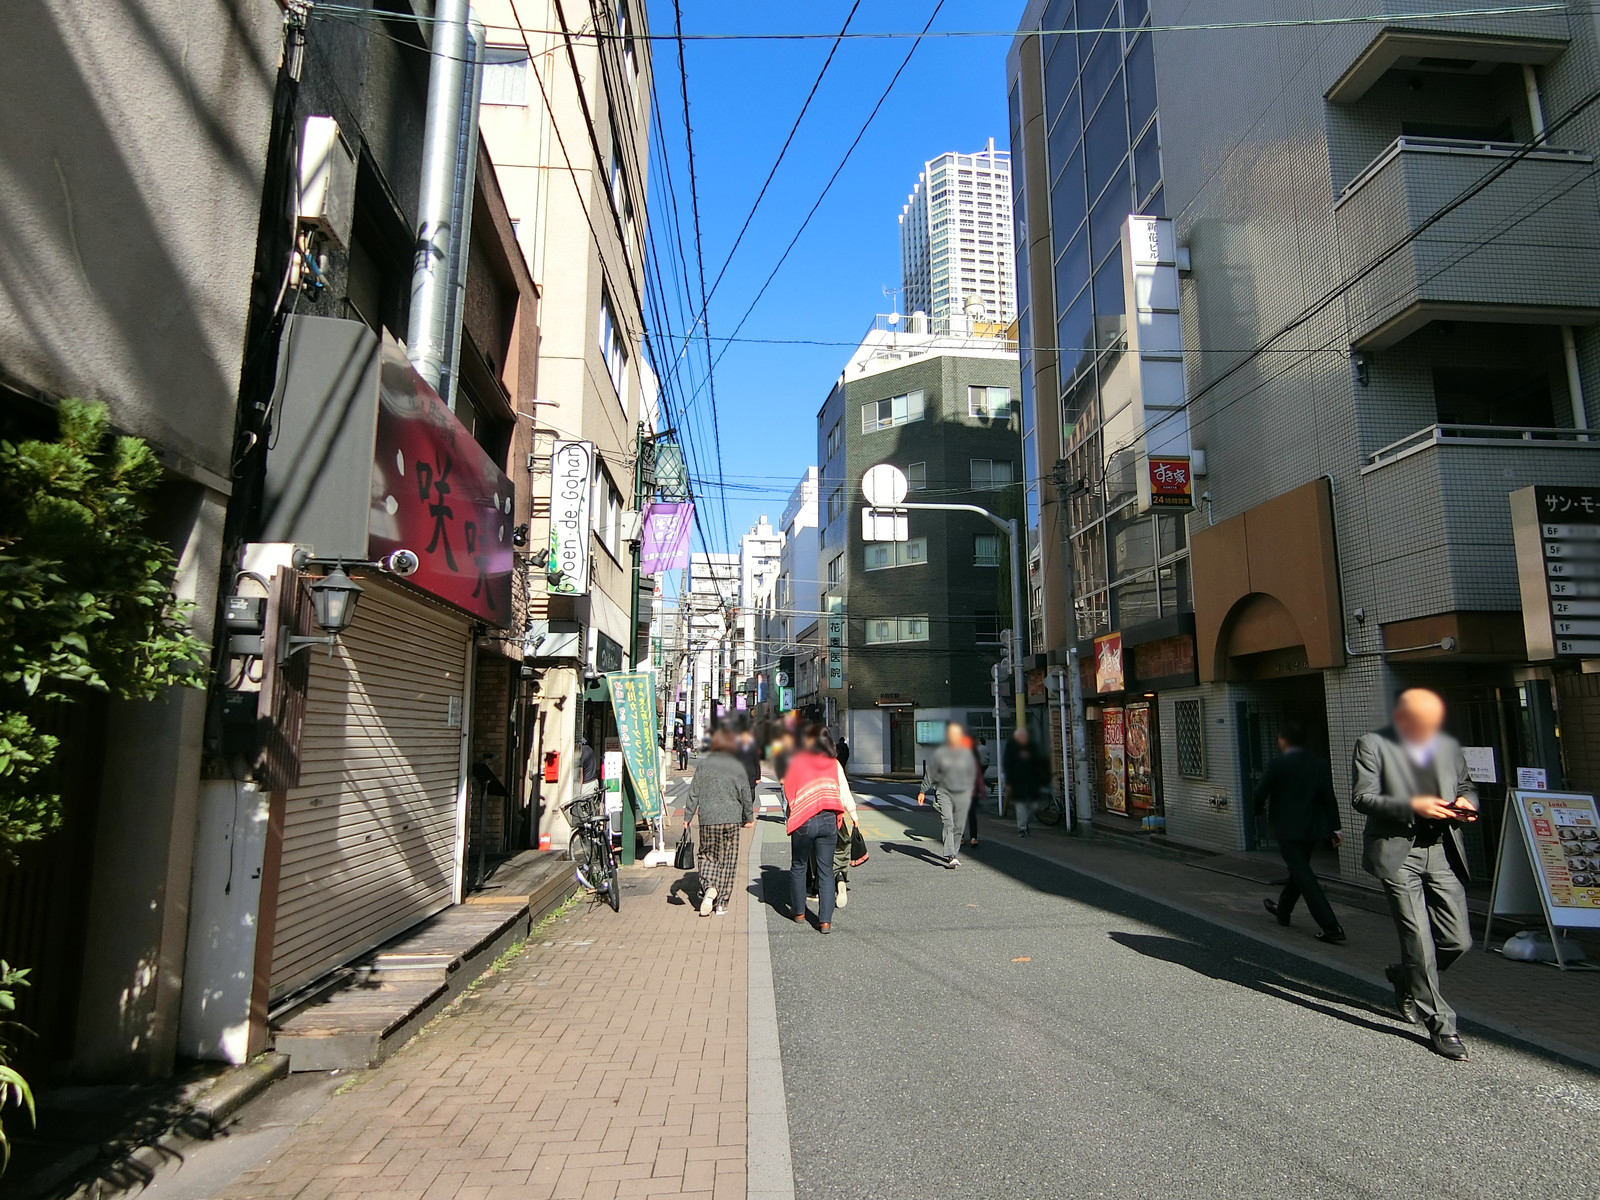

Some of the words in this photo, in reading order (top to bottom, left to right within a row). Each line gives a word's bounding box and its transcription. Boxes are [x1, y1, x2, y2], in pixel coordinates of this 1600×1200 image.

[1147, 221, 1160, 259] 新花ビル
[1153, 462, 1187, 486] すき家
[1547, 526, 1558, 535] 6F
[1550, 545, 1560, 554] 5F
[1552, 564, 1563, 573] 4F
[1554, 584, 1566, 593] 3F
[1557, 603, 1568, 612] 2F
[1559, 623, 1571, 632] 1F
[1561, 642, 1572, 651] B1
